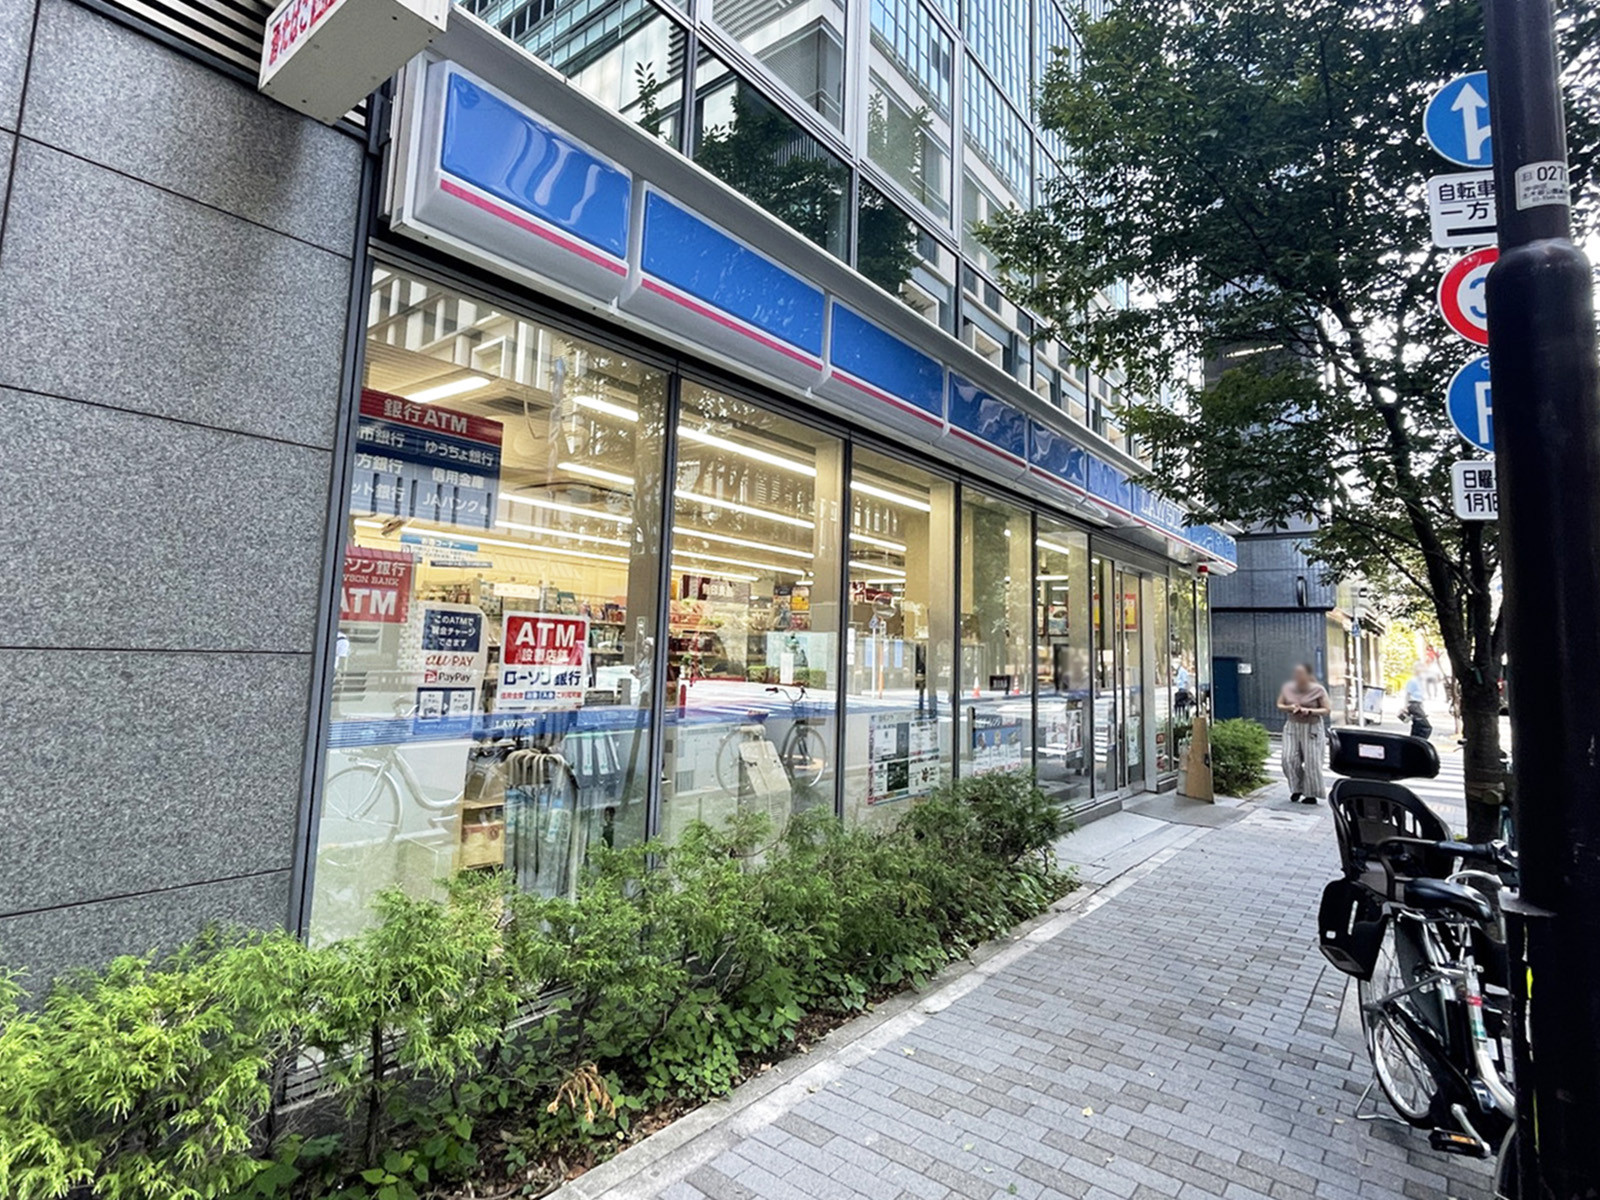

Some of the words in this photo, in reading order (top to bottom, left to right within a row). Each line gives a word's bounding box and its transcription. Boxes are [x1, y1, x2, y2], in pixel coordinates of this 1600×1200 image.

[357, 425, 406, 448] 市銀行
[354, 453, 403, 474] 方銀行
[425, 440, 494, 467] ゆうちょ銀行
[432, 467, 485, 489] 信用金庫
[344, 558, 406, 577] ソン銀行
[434, 615, 475, 626] このATMで
[515, 621, 576, 648] ATM
[452, 656, 475, 667] PAY
[438, 671, 472, 683] PayPay
[503, 670, 582, 686] ローソン銀行
